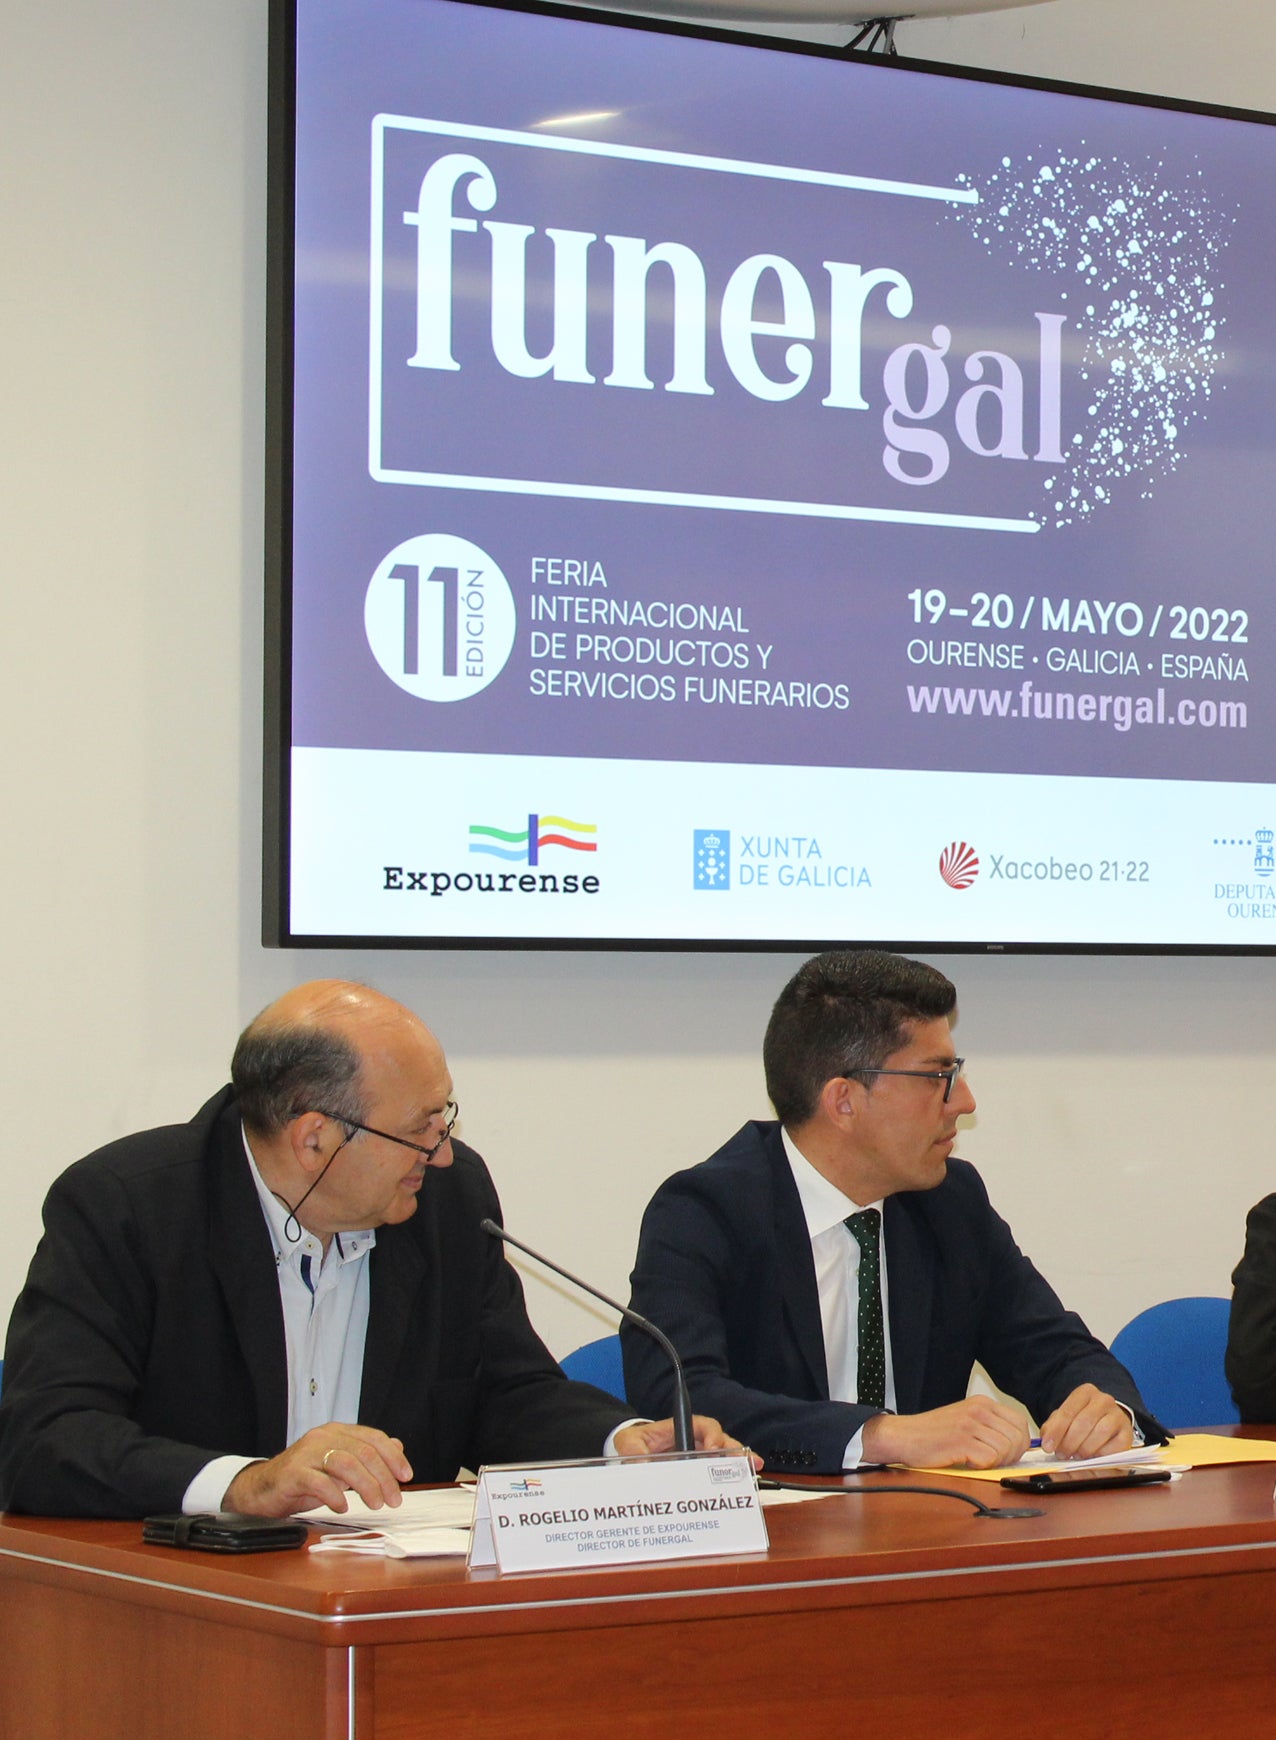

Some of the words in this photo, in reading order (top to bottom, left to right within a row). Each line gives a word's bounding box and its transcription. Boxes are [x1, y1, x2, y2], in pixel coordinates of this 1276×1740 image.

[532, 557, 608, 588] FERIA
[387, 564, 458, 676] 11
[461, 569, 484, 678] EDICIÓN
[532, 594, 749, 632] INTERNACIONAL
[1042, 597, 1143, 637] MAYO
[1169, 605, 1249, 643] 2022
[531, 632, 566, 660] DE
[576, 634, 749, 667] PRODUCTOS
[757, 645, 773, 669] Y
[907, 639, 1024, 670] OURENSE
[1046, 647, 1140, 676] GALICIA
[1161, 652, 1249, 682] ESPAÑA
[530, 669, 676, 701] SERVICIOS
[685, 676, 850, 709] FUNERARIOS
[907, 681, 1247, 731] www.funergal.com
[740, 836, 822, 859] XUNTA
[383, 867, 600, 896] Expourense
[740, 864, 769, 886] DE
[778, 865, 872, 888] GALICIA
[989, 854, 1093, 881] Xacobeo
[491, 1490, 545, 1501] Expourense
[498, 1516, 515, 1529] D.
[519, 1508, 589, 1528] ROGELIO
[593, 1499, 673, 1521] MARTÍNEZ
[676, 1494, 754, 1513] GONZÁLEZ
[545, 1531, 594, 1543] DIRECTOR
[596, 1527, 640, 1539] GERENTE
[643, 1525, 655, 1535] DE
[658, 1520, 720, 1533] EXPOURENSE
[577, 1540, 625, 1552] DIRECTOR
[628, 1538, 640, 1547] DE
[643, 1535, 693, 1546] FUNERGAL
